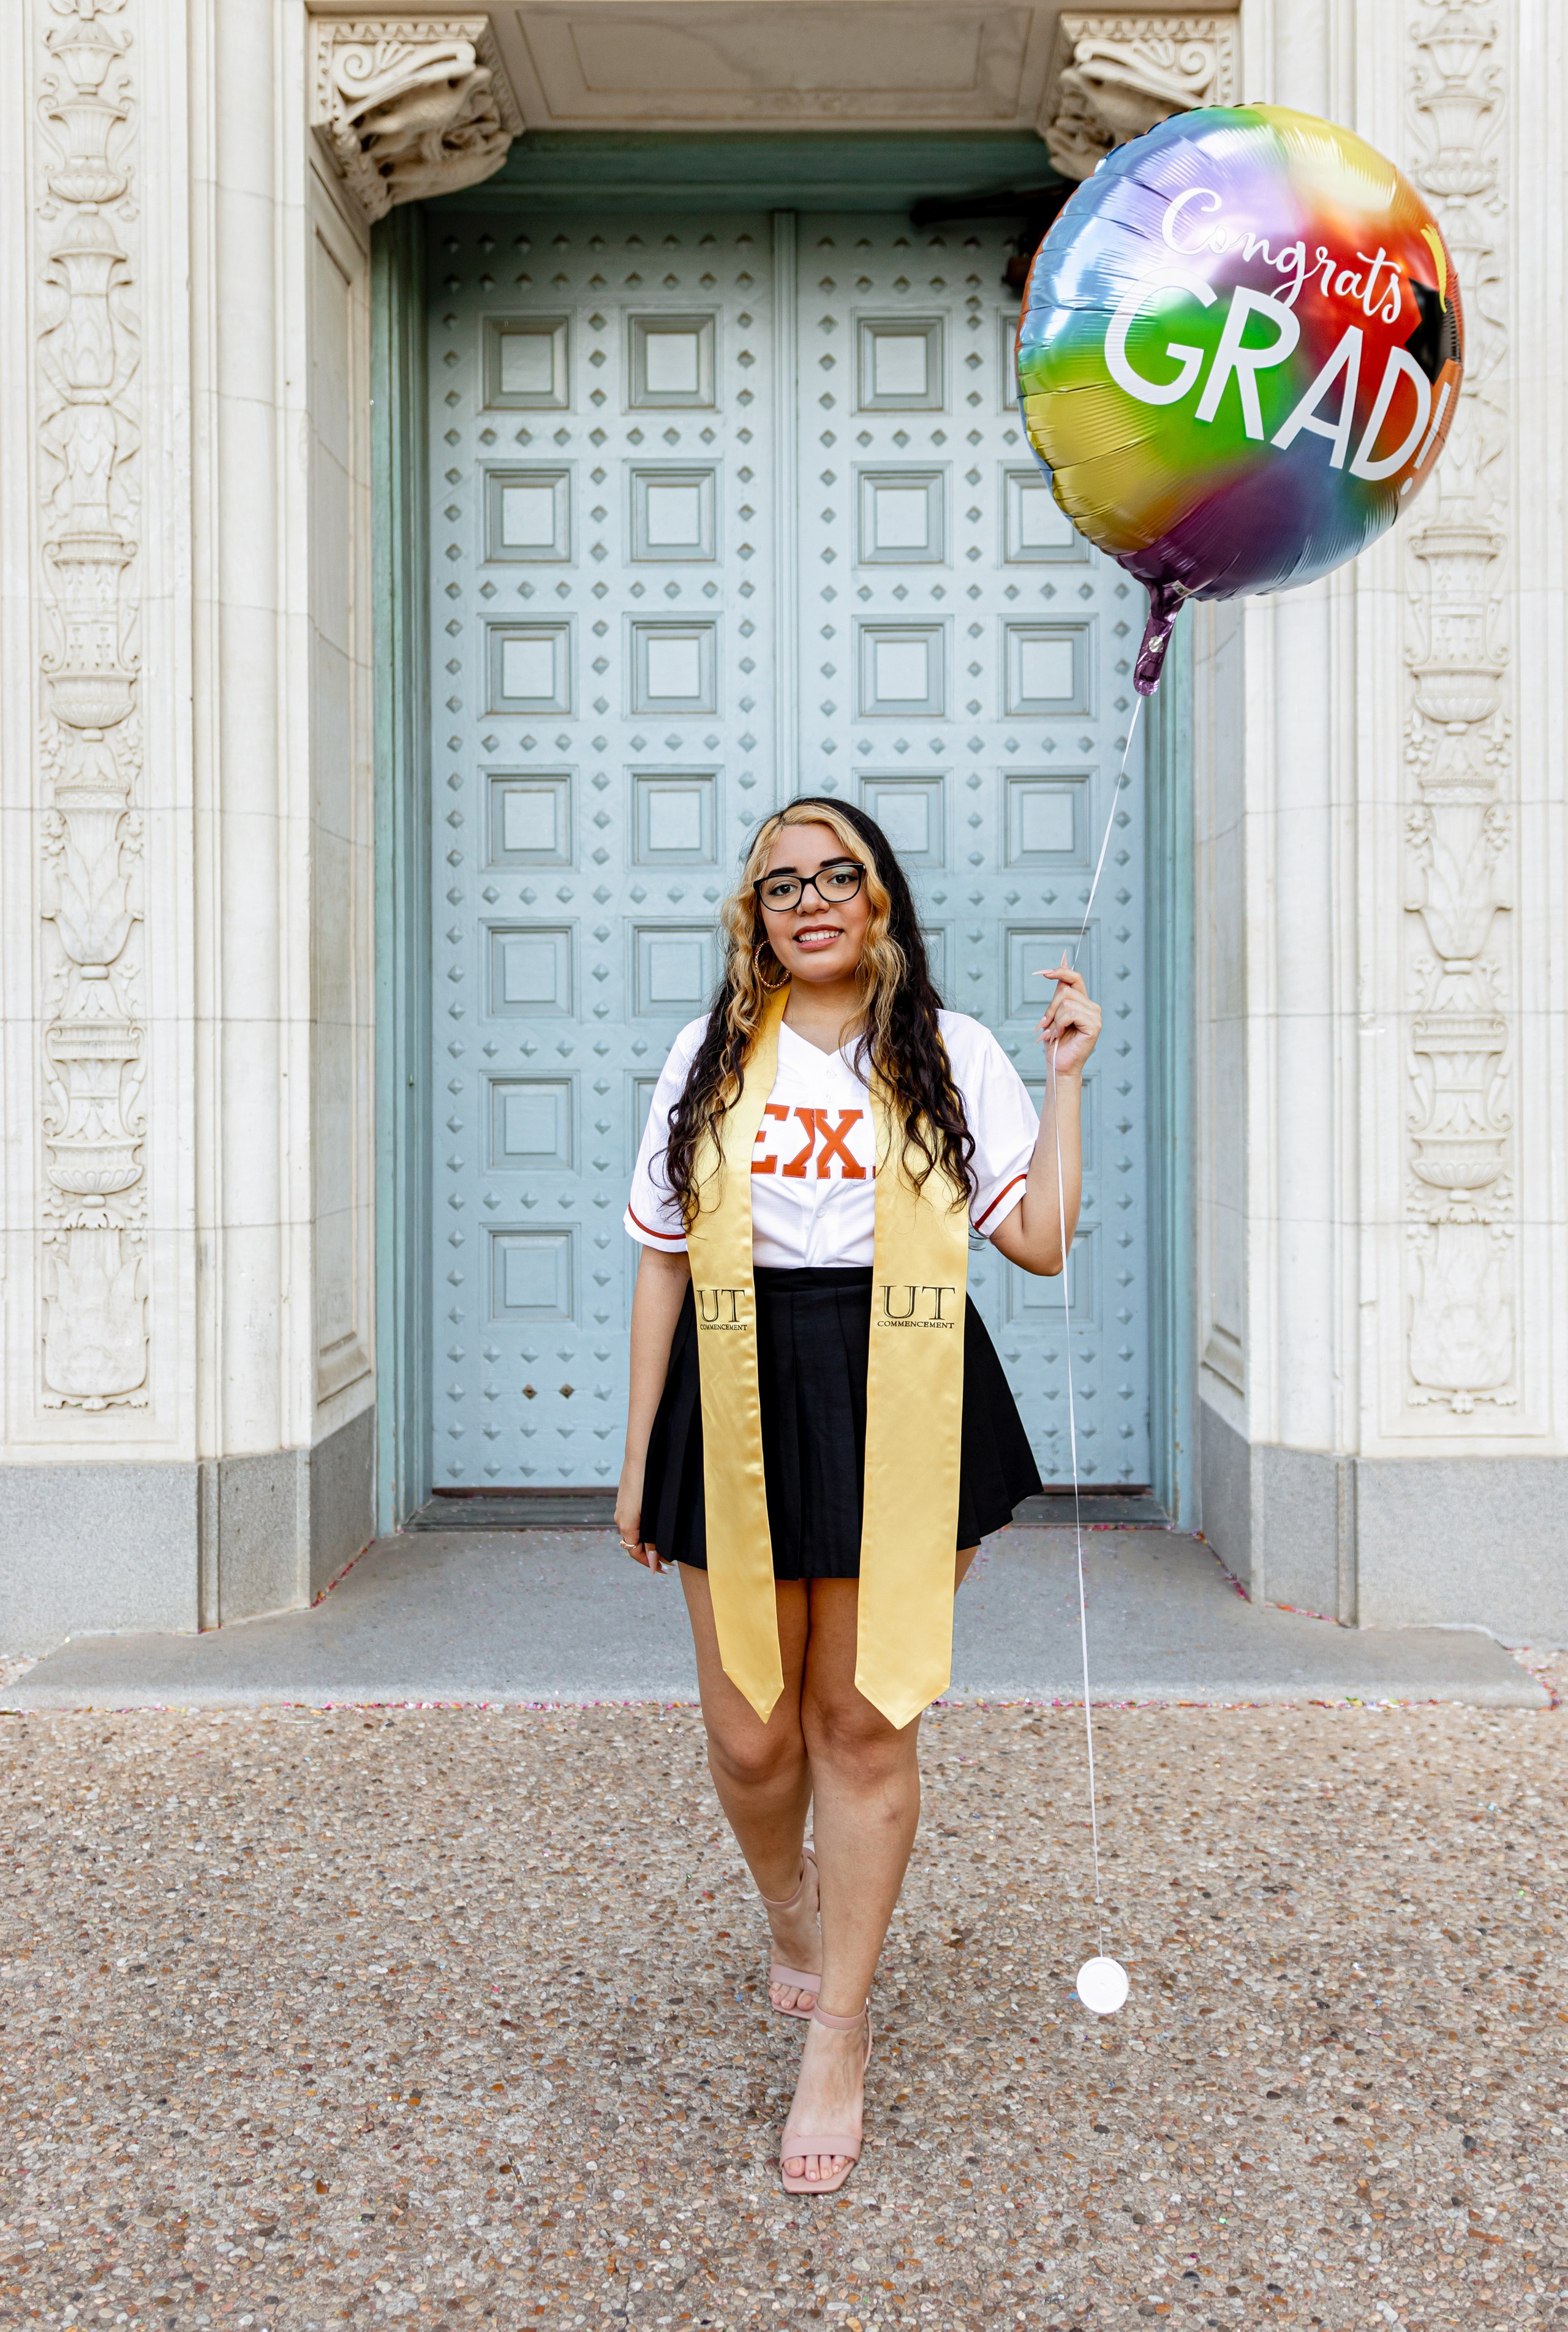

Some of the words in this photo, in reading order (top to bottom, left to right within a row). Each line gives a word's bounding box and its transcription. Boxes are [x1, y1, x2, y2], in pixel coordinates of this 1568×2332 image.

[1162, 187, 1401, 323] Congrats
[1104, 267, 1452, 496] GRAD!
[696, 1289, 745, 1323] UT
[879, 1285, 956, 1320] UT
